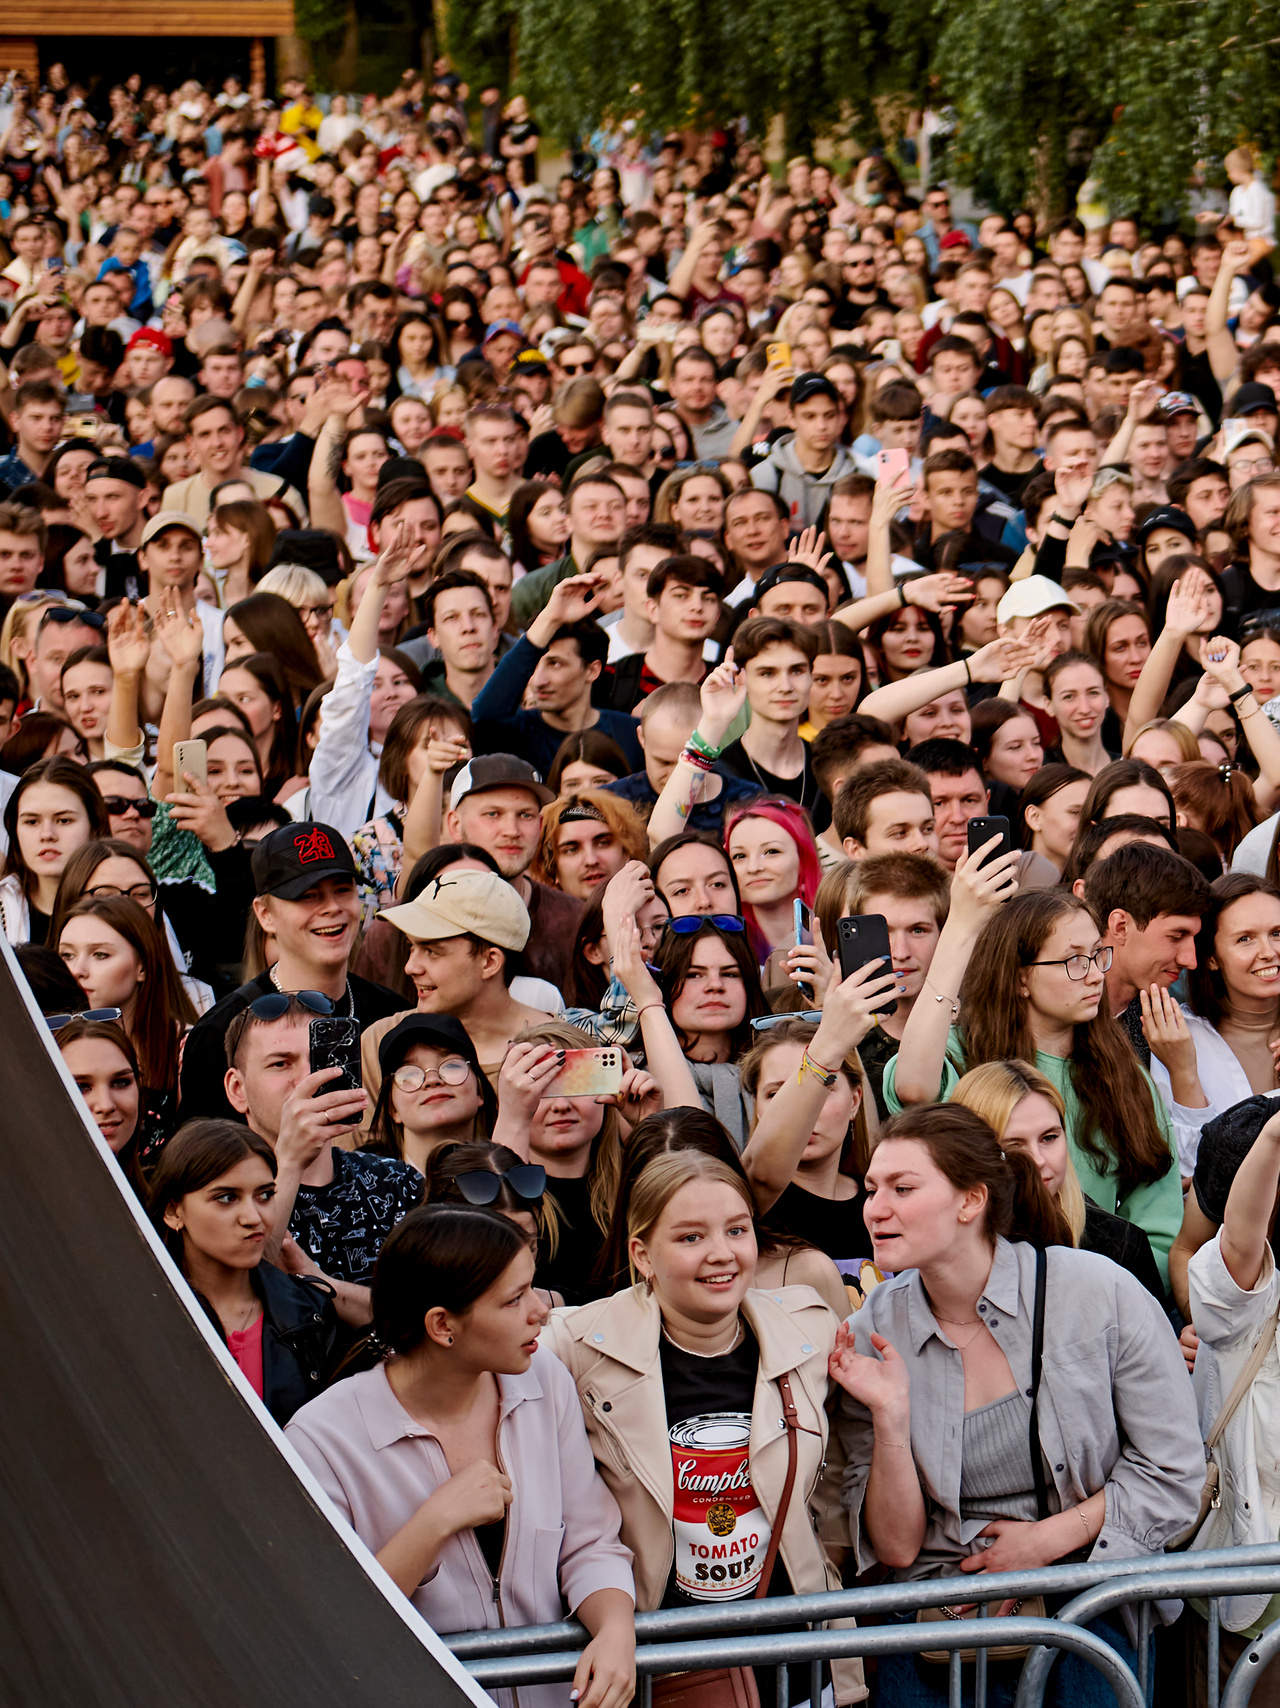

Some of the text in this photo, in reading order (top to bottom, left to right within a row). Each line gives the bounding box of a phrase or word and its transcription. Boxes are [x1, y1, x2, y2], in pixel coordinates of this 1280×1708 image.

[692, 1494, 751, 1503] CONDENSED
[688, 1532, 759, 1560] TOMATO
[694, 1553, 756, 1582] SOUP
